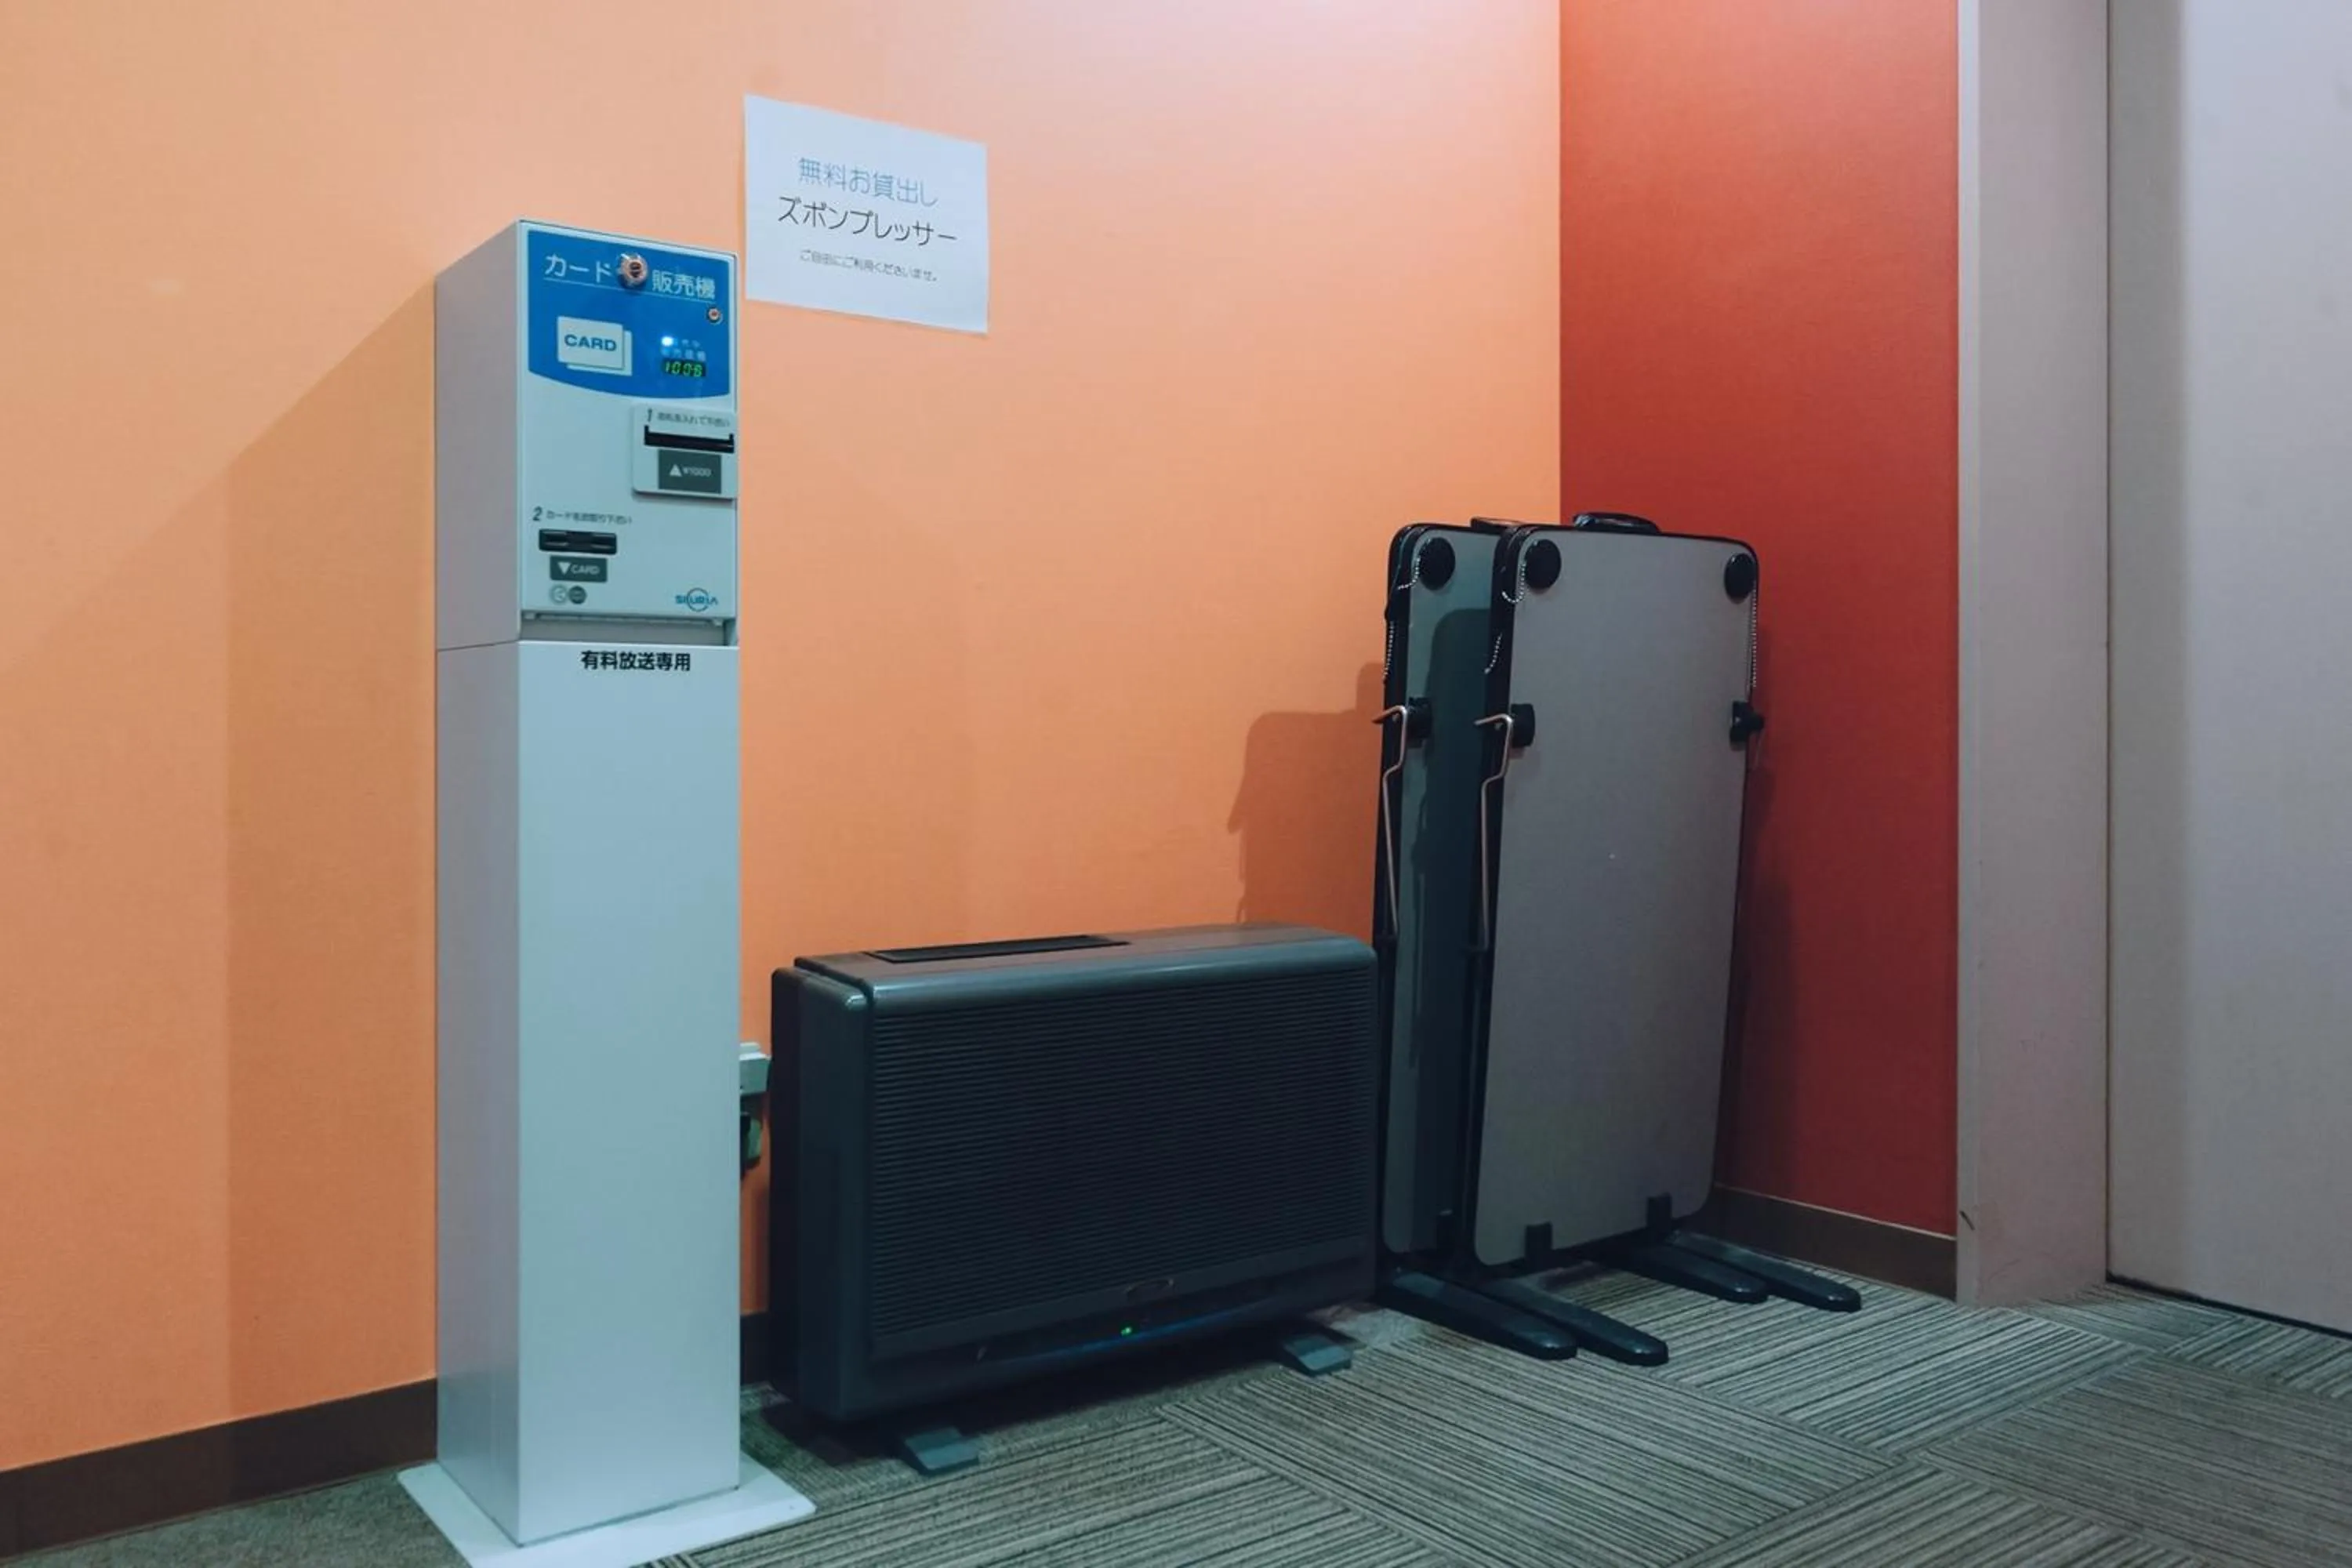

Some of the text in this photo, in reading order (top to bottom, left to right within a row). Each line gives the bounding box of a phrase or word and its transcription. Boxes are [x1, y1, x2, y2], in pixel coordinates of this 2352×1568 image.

[798, 157, 938, 208] 無料お貸出し
[544, 252, 717, 300] カード 販売機
[564, 333, 618, 353] CARD
[532, 506, 543, 521] 2
[580, 649, 691, 672] 有料放送専用
